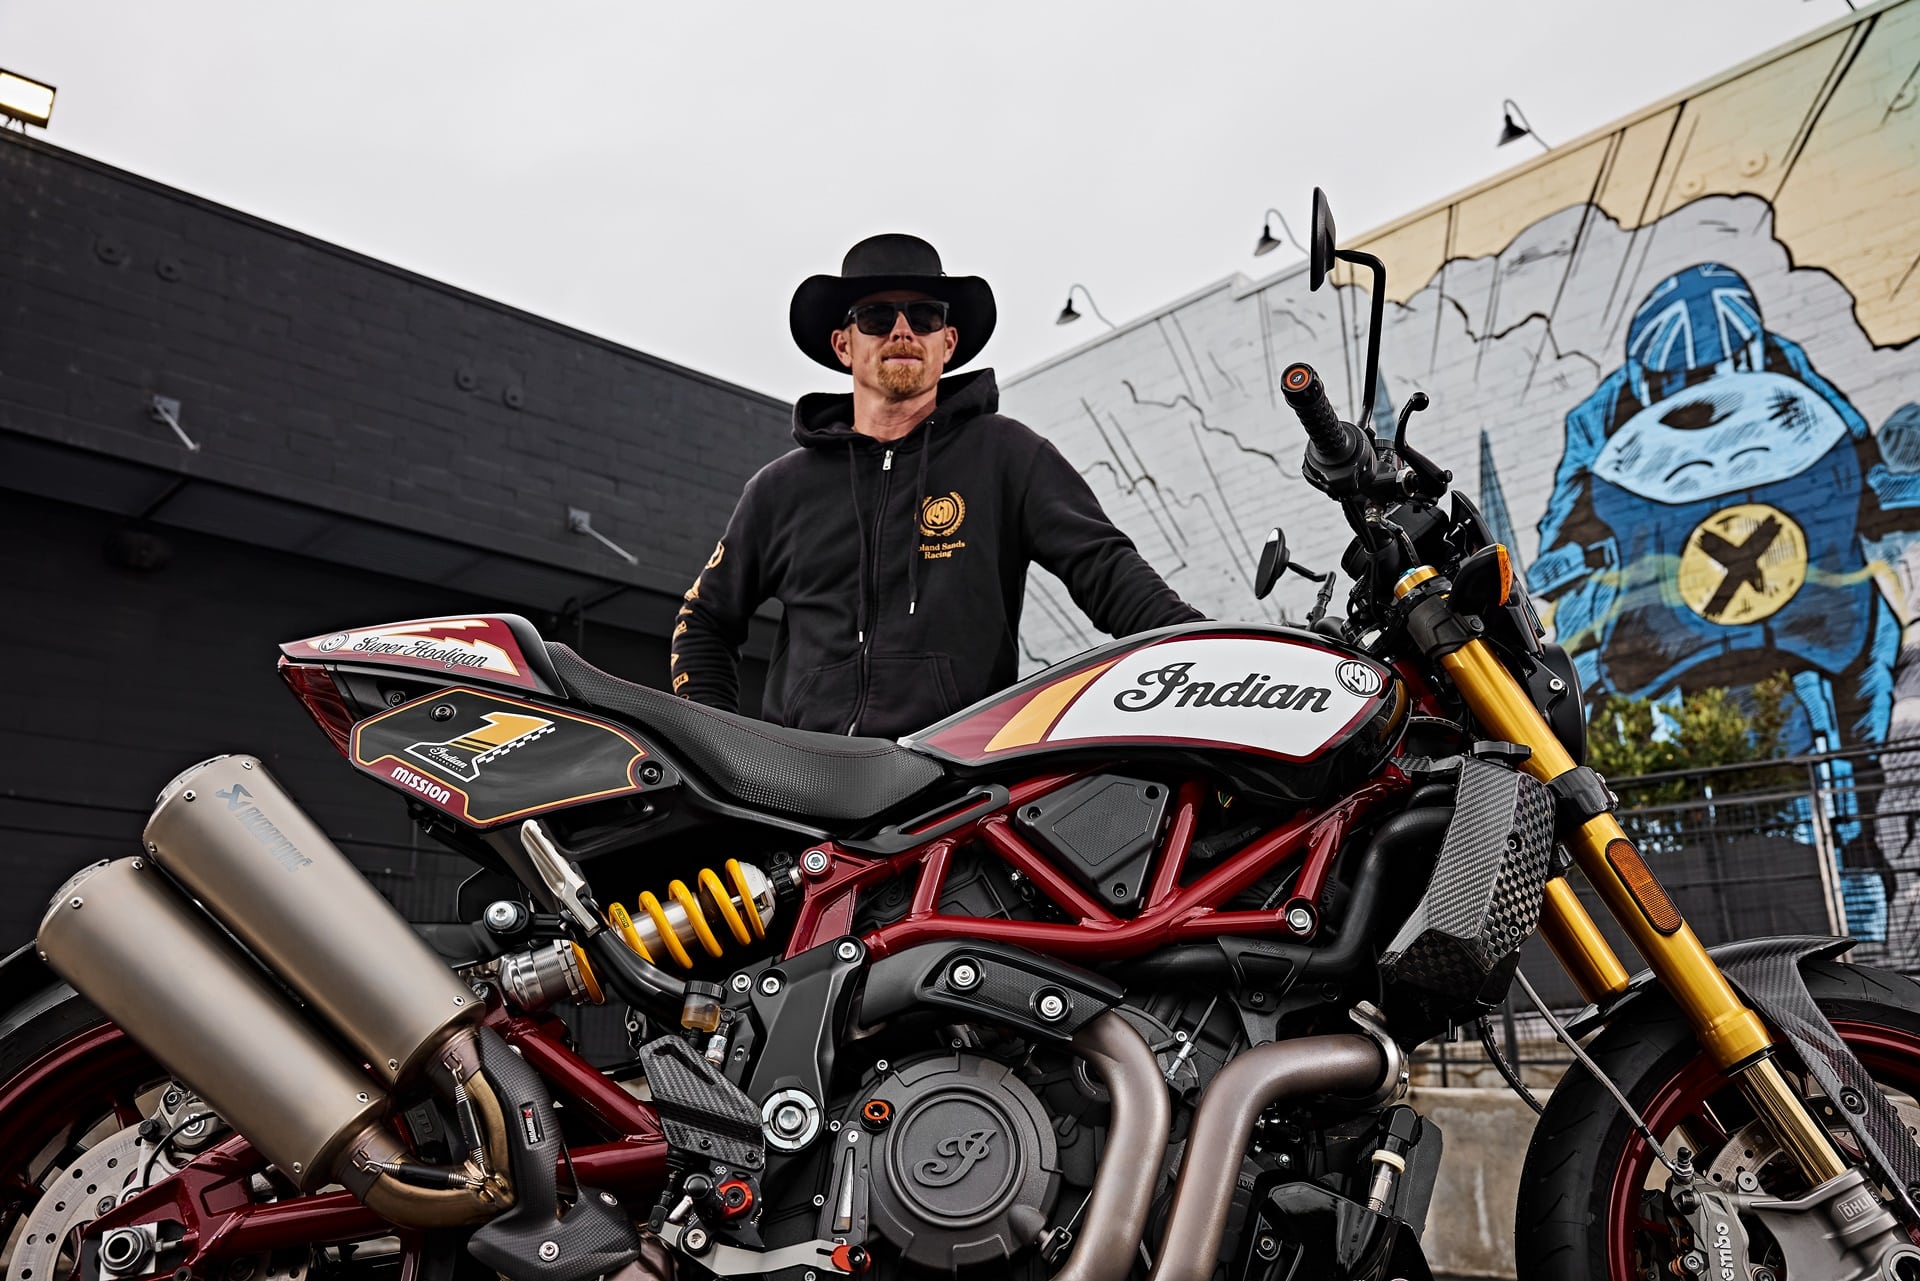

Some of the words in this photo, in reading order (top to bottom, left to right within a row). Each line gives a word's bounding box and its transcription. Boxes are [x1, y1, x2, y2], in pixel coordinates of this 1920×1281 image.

[924, 550, 952, 559] Racing
[941, 540, 966, 550] Sands
[352, 636, 408, 657] Super
[403, 640, 488, 668] Hooligan
[1113, 662, 1332, 713] Indian
[429, 746, 468, 769] Indian
[391, 766, 451, 804] MISSION
[1840, 1191, 1880, 1218] ÖHLIS
